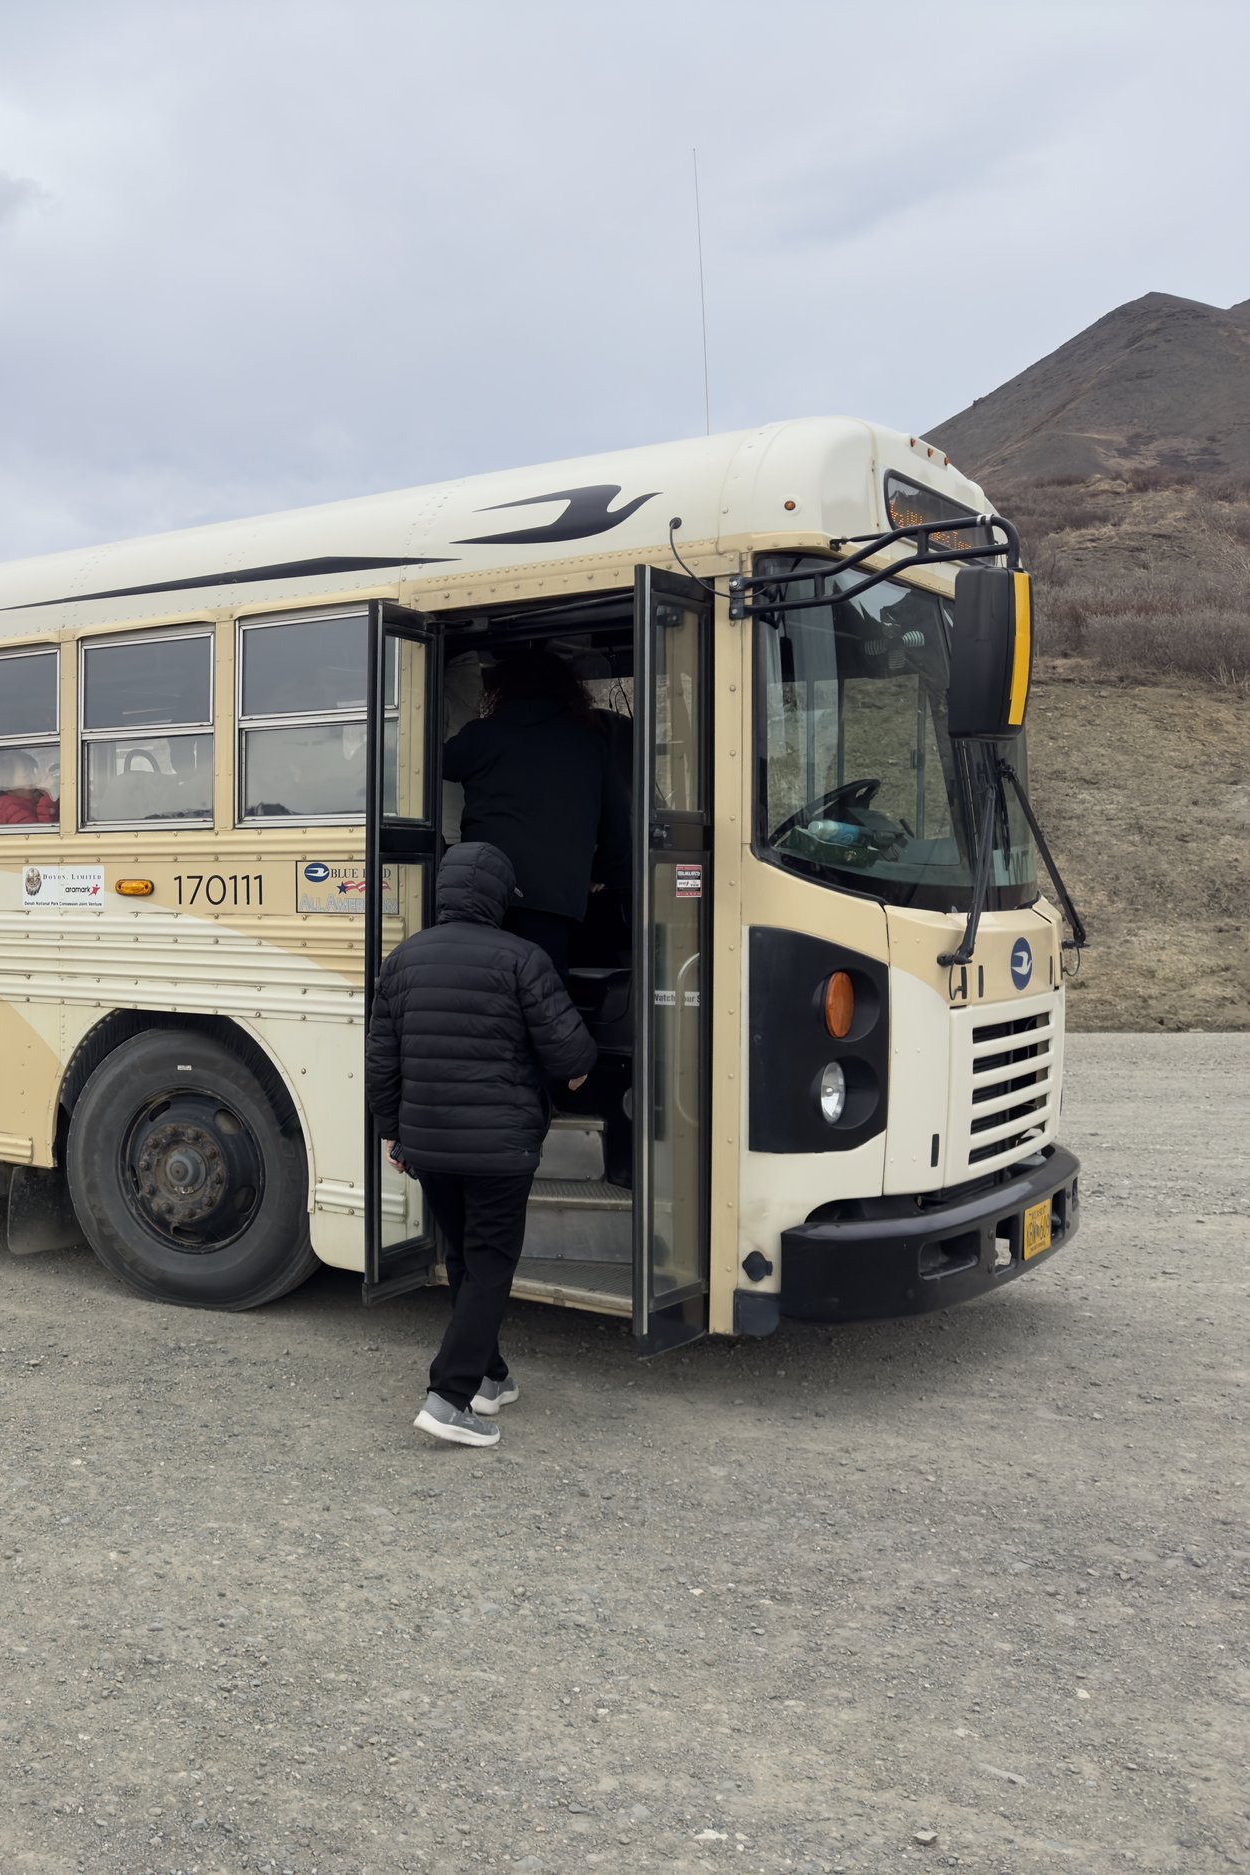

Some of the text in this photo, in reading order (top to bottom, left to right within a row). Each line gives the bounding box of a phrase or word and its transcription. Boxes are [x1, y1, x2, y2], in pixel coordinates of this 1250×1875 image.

[331, 868, 358, 878] BLUE
[65, 885, 91, 893] aramark
[173, 874, 263, 906] 170111
